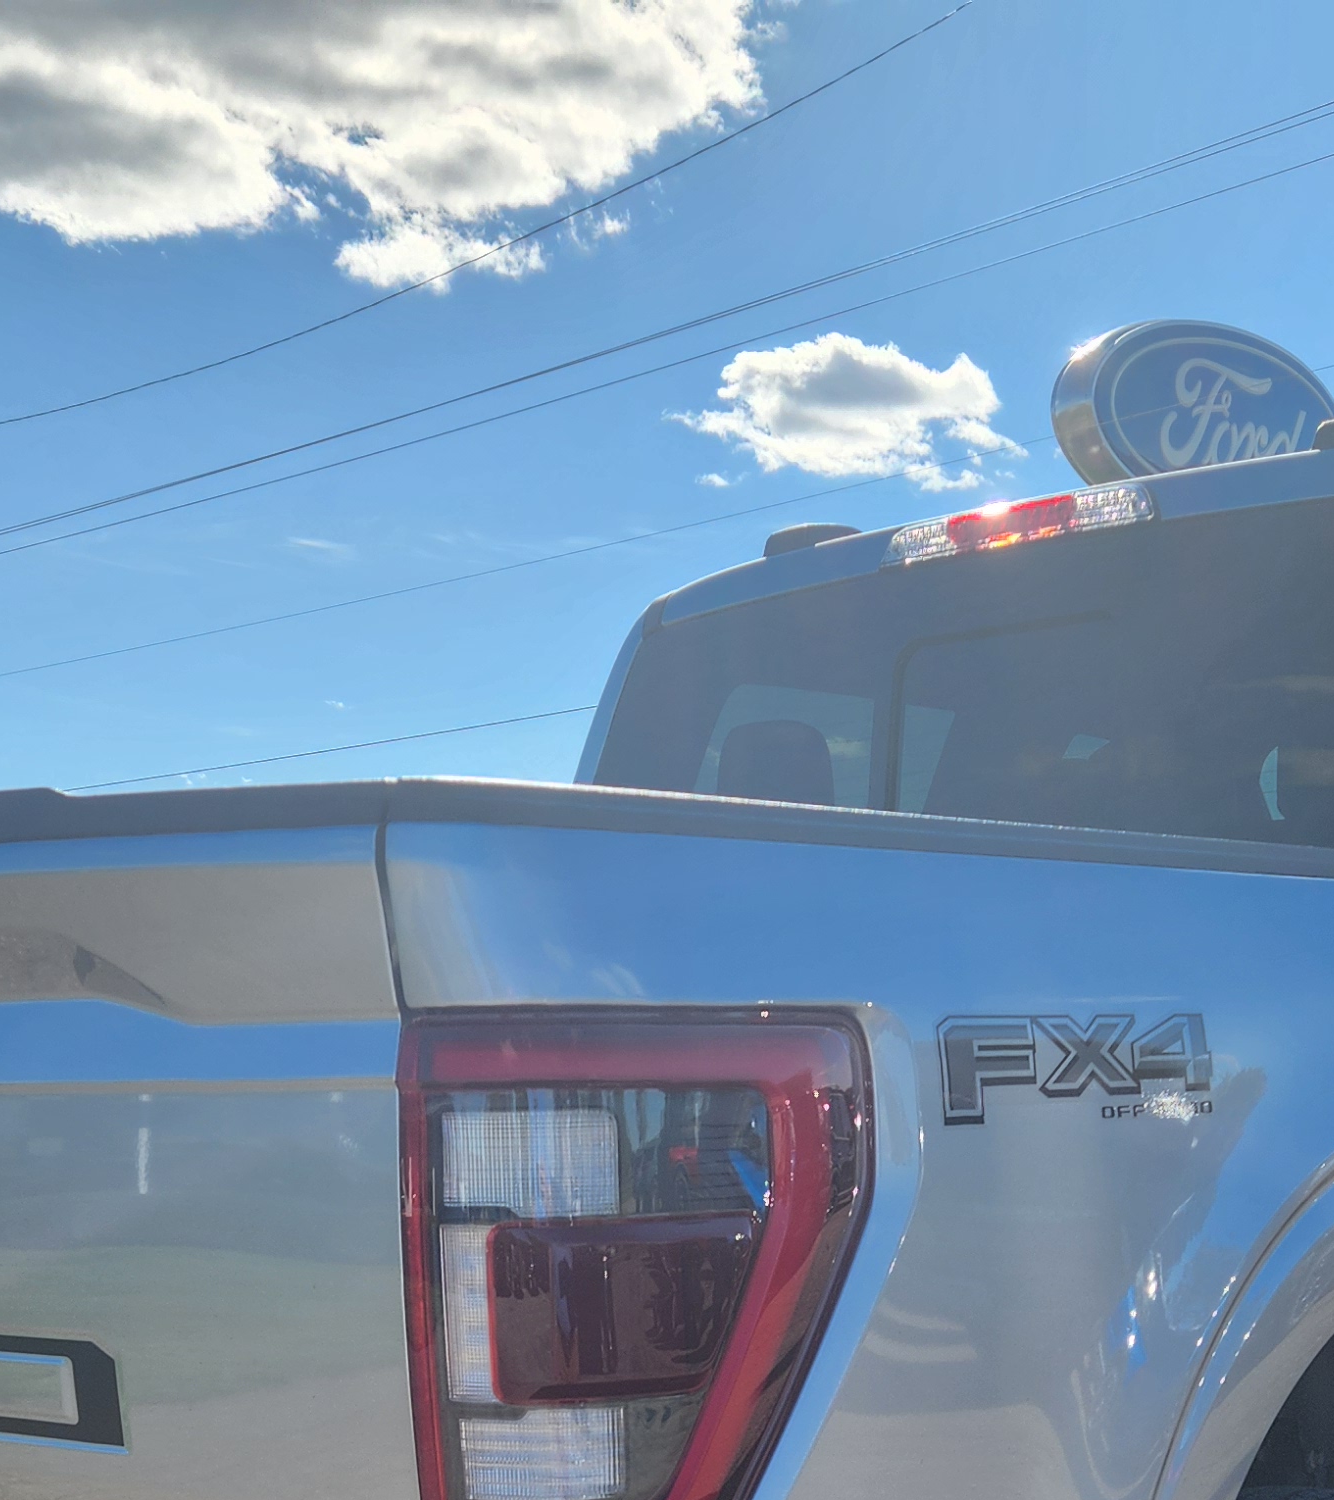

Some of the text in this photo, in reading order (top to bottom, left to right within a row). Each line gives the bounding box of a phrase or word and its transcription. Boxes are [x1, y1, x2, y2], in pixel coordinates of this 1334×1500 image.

[1160, 358, 1307, 468] Ford
[936, 1013, 1213, 1126] FX4
[1101, 1104, 1146, 1119] OFF
